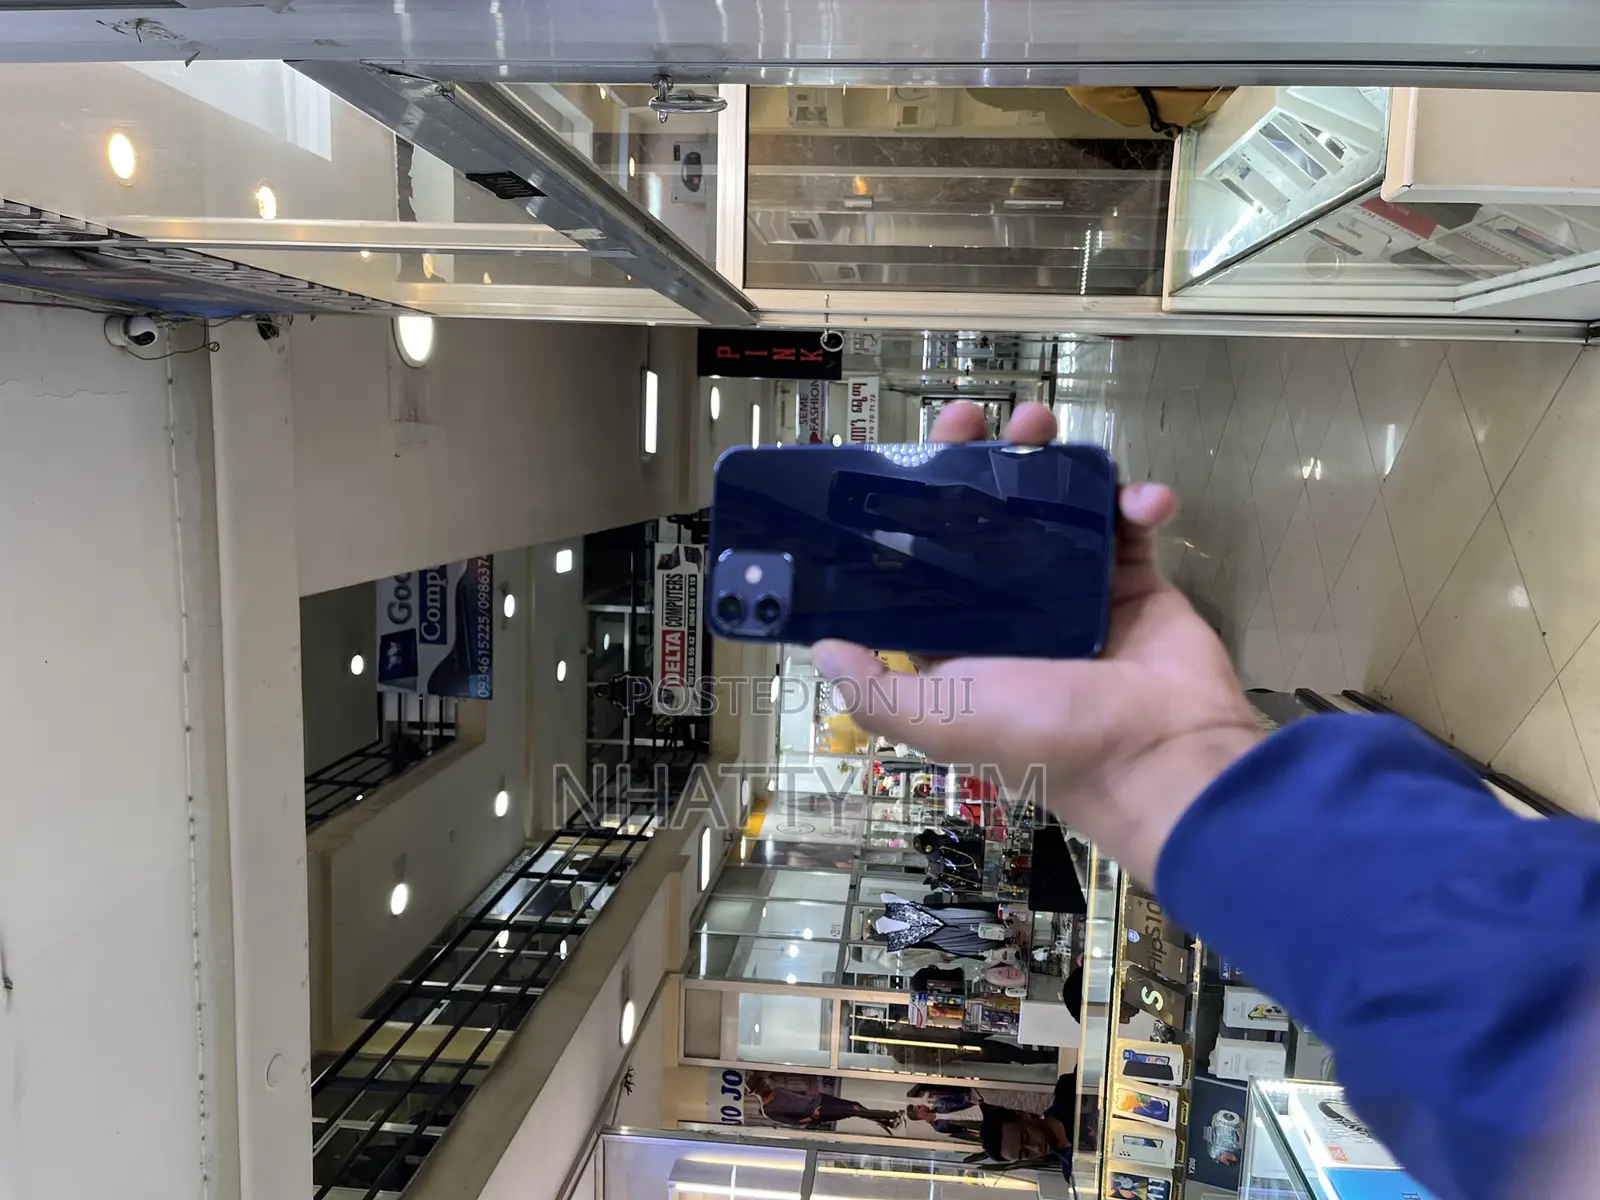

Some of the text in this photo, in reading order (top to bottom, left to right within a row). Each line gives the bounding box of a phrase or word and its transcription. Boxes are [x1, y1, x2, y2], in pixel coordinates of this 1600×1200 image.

[716, 346, 822, 362] PINK
[809, 380, 820, 432] FASHION
[664, 573, 684, 684] DELTA COMPUTERS
[1148, 938, 1168, 974] Flip
[1141, 986, 1164, 1010] S
